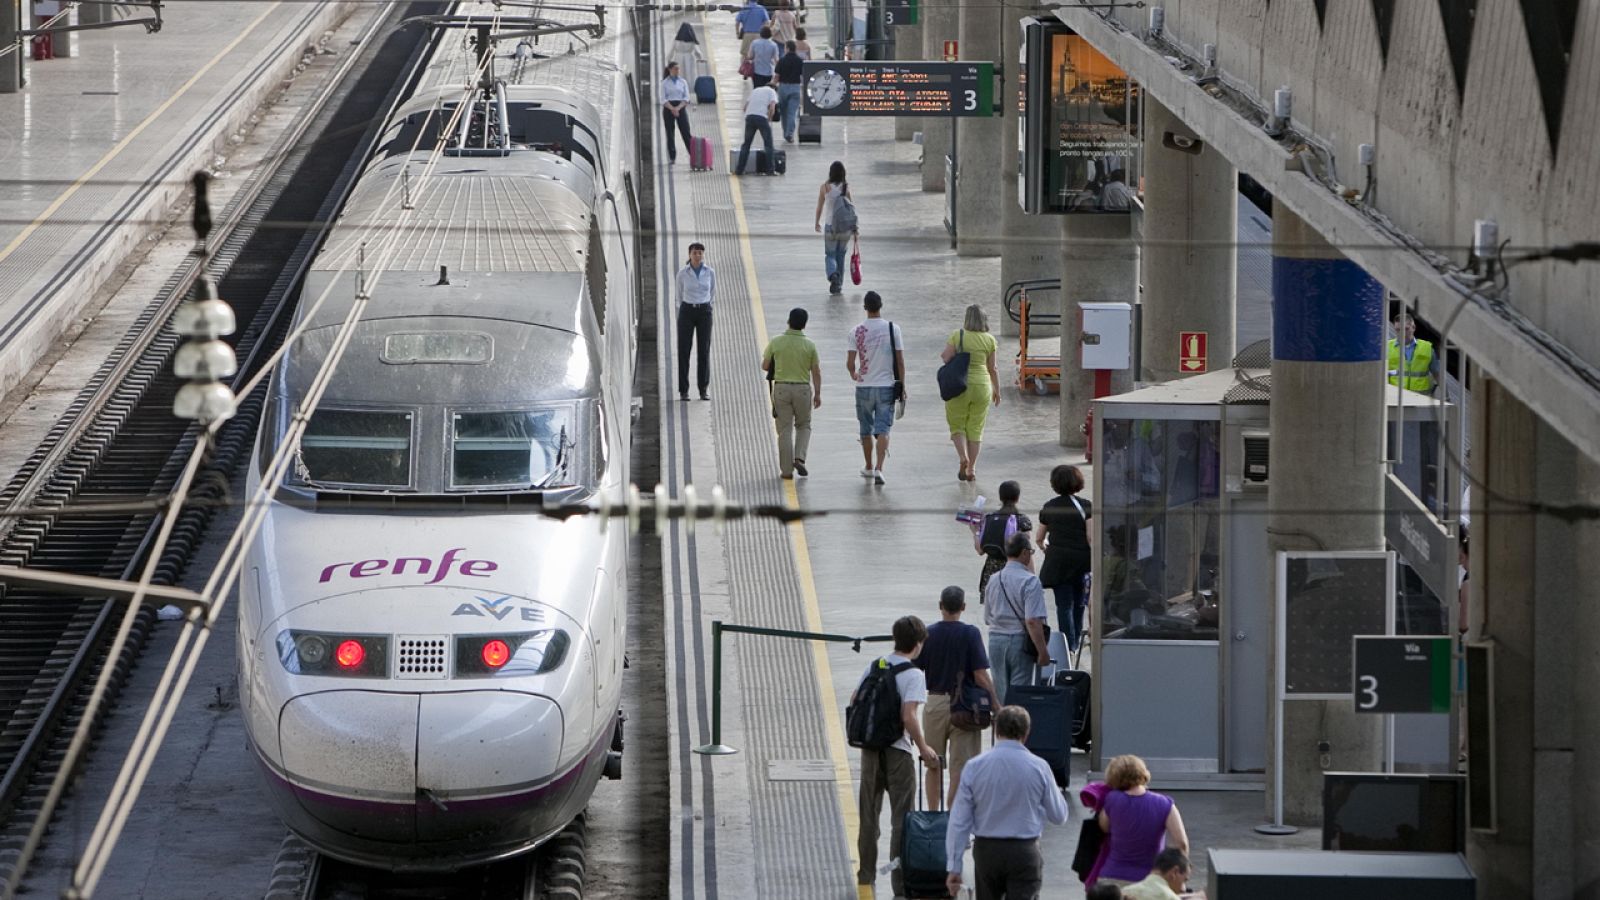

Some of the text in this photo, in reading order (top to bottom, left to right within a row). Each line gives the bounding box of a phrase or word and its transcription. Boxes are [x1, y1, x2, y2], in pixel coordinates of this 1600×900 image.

[886, 11, 894, 25] 3
[964, 89, 977, 111] 3
[1060, 140, 1091, 148] Seguimos
[318, 548, 498, 584] renfe
[451, 598, 546, 623] AVE
[1359, 675, 1379, 709] 3
